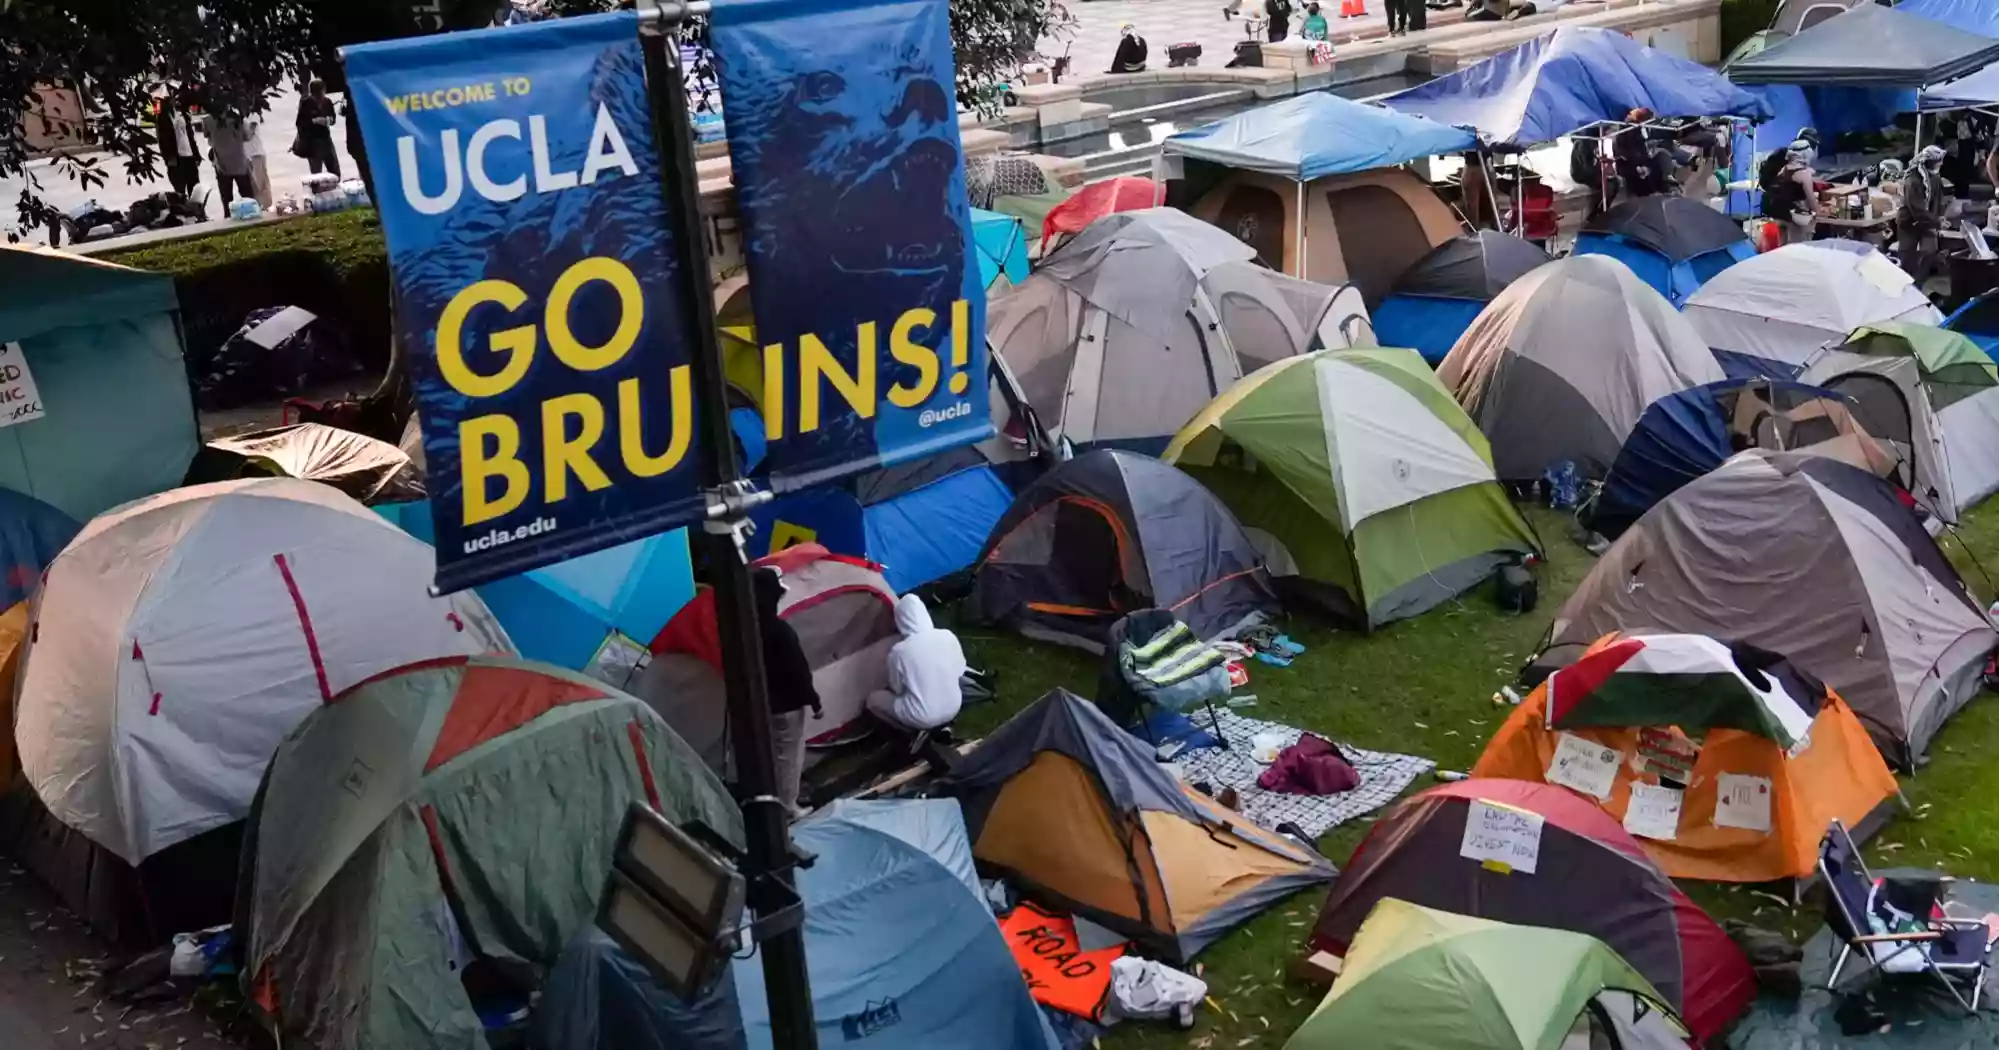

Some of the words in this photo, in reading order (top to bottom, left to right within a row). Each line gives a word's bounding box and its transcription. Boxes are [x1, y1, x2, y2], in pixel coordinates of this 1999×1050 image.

[386, 82, 496, 115] WELCOME
[502, 77, 531, 97] TO
[397, 101, 640, 215] UCLA
[436, 256, 645, 397] GO
[764, 299, 968, 441] INS!
[459, 364, 693, 527] BRU
[918, 400, 972, 428] @ucla
[463, 517, 557, 554] ucla.edu
[1016, 925, 1097, 978] ROAD
